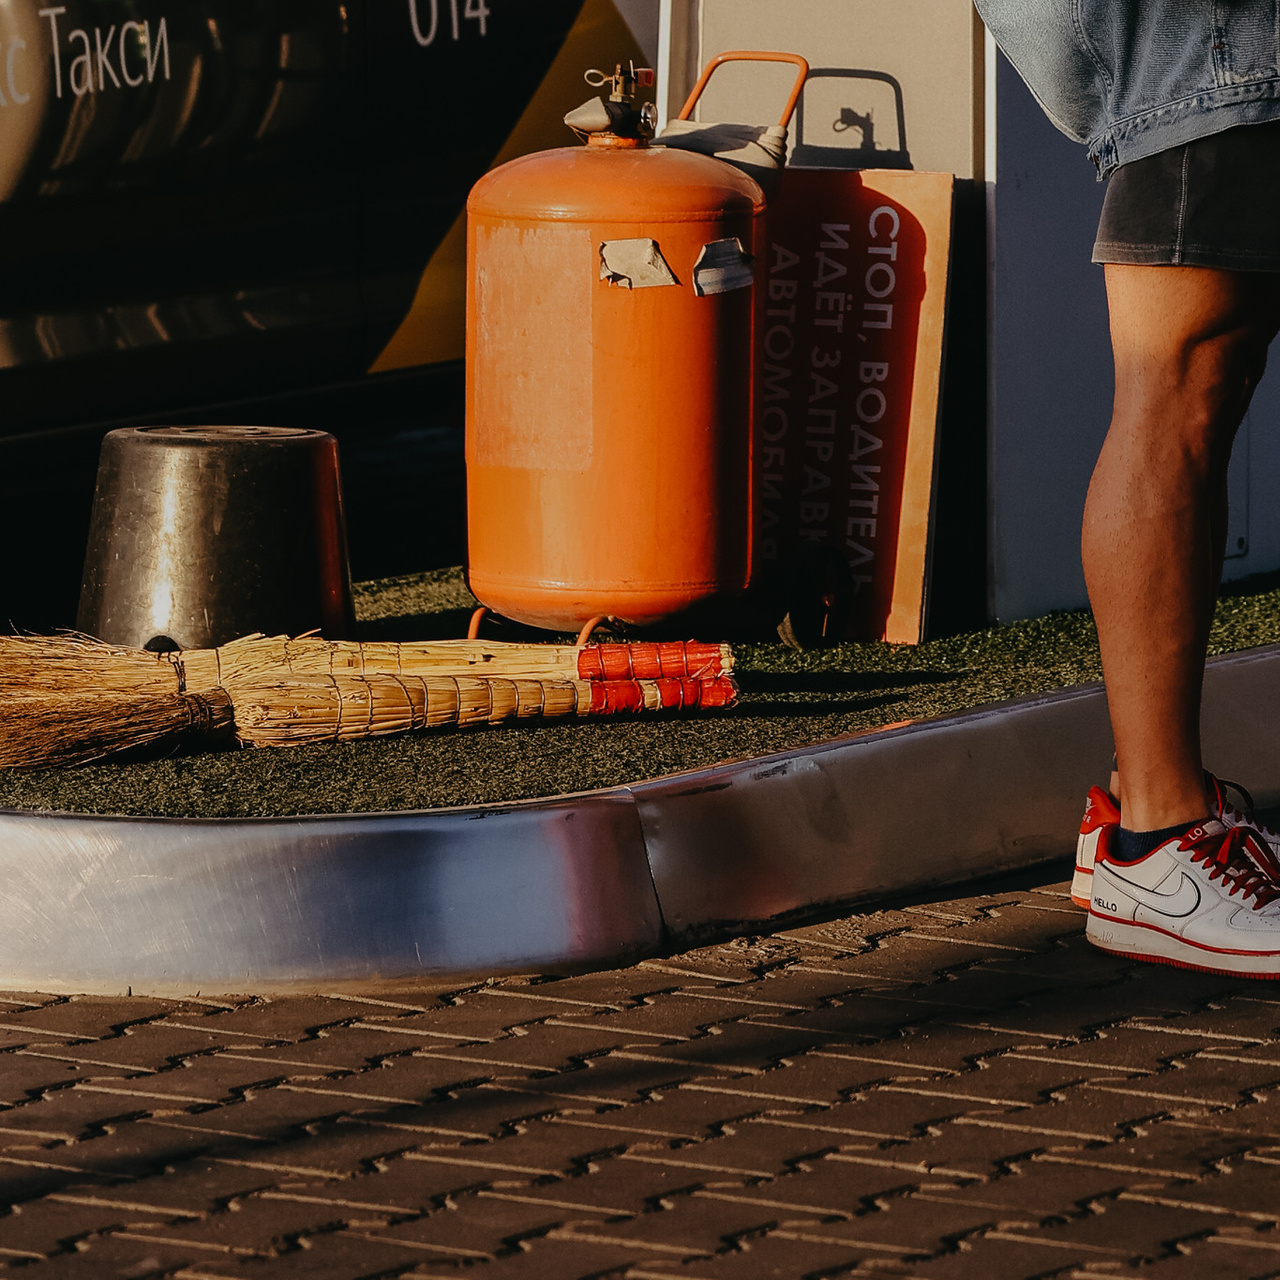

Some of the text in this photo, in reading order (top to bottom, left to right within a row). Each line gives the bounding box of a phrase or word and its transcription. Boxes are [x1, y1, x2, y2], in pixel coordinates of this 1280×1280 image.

[38, 5, 171, 99] Такси
[857, 205, 901, 343] СТОП,
[797, 222, 853, 542] ИДЁТ ЗАПРАВК
[1094, 896, 1118, 913] HELLO
